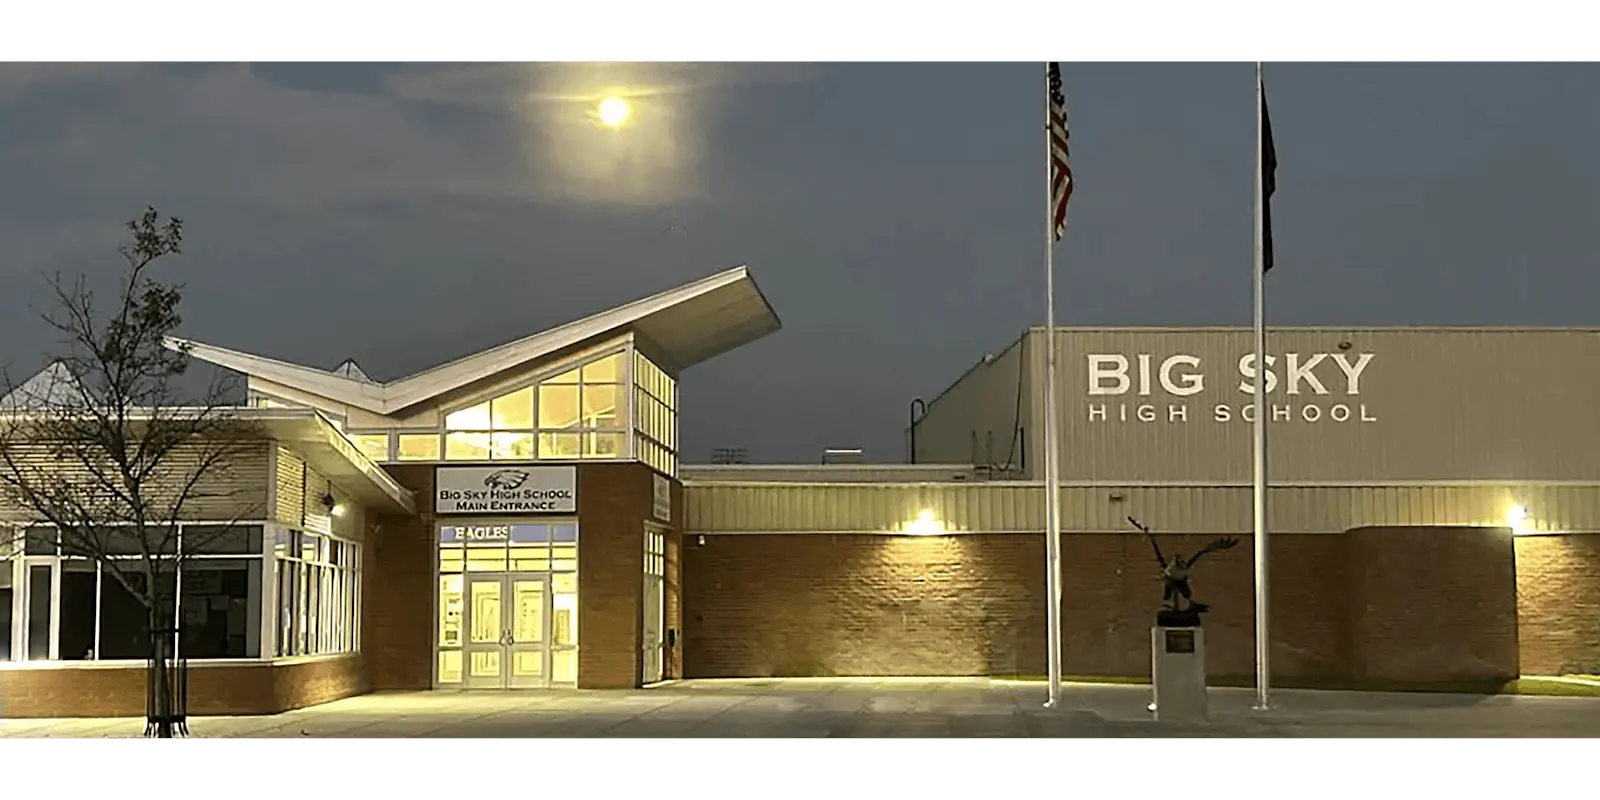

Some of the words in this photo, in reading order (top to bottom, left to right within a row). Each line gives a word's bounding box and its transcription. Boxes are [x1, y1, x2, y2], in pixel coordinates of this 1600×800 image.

[1088, 353, 1205, 396] BIG
[1239, 353, 1375, 395] SKY
[1088, 403, 1187, 422] HIGH
[1214, 403, 1377, 423] SCHOOL
[440, 490, 461, 500] BIG
[464, 490, 488, 500] SKY
[490, 490, 520, 500] HIGH
[523, 489, 572, 499] SCHOOL
[456, 501, 487, 510] MAIN
[490, 501, 556, 510] ENTRANCE
[455, 525, 508, 540] EAGLES
